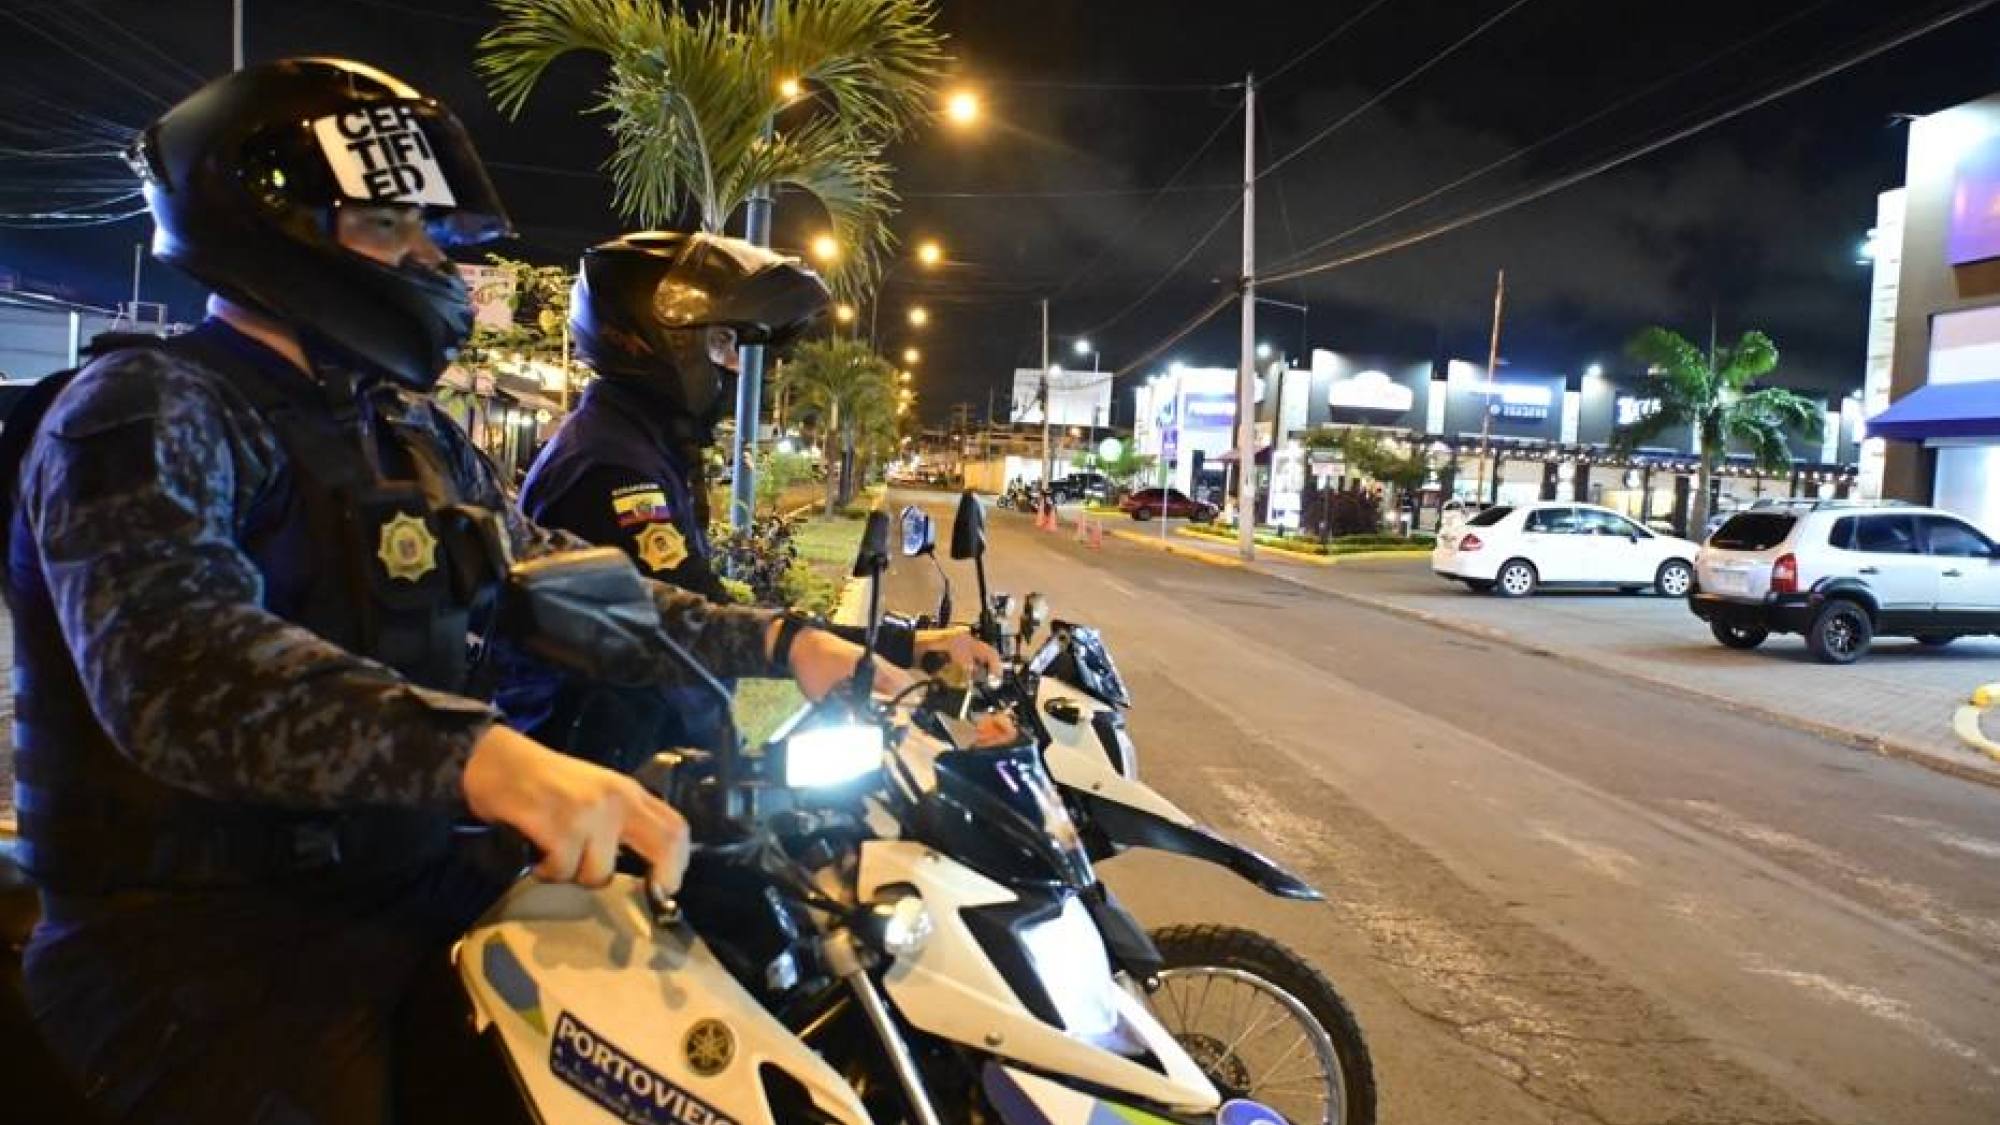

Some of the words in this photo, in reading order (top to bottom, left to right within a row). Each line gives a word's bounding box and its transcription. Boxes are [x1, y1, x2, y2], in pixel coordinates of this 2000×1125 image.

[346, 130, 432, 171] TIFI
[362, 163, 426, 199] ED
[558, 1015, 732, 1125] PORTOVIEJ
